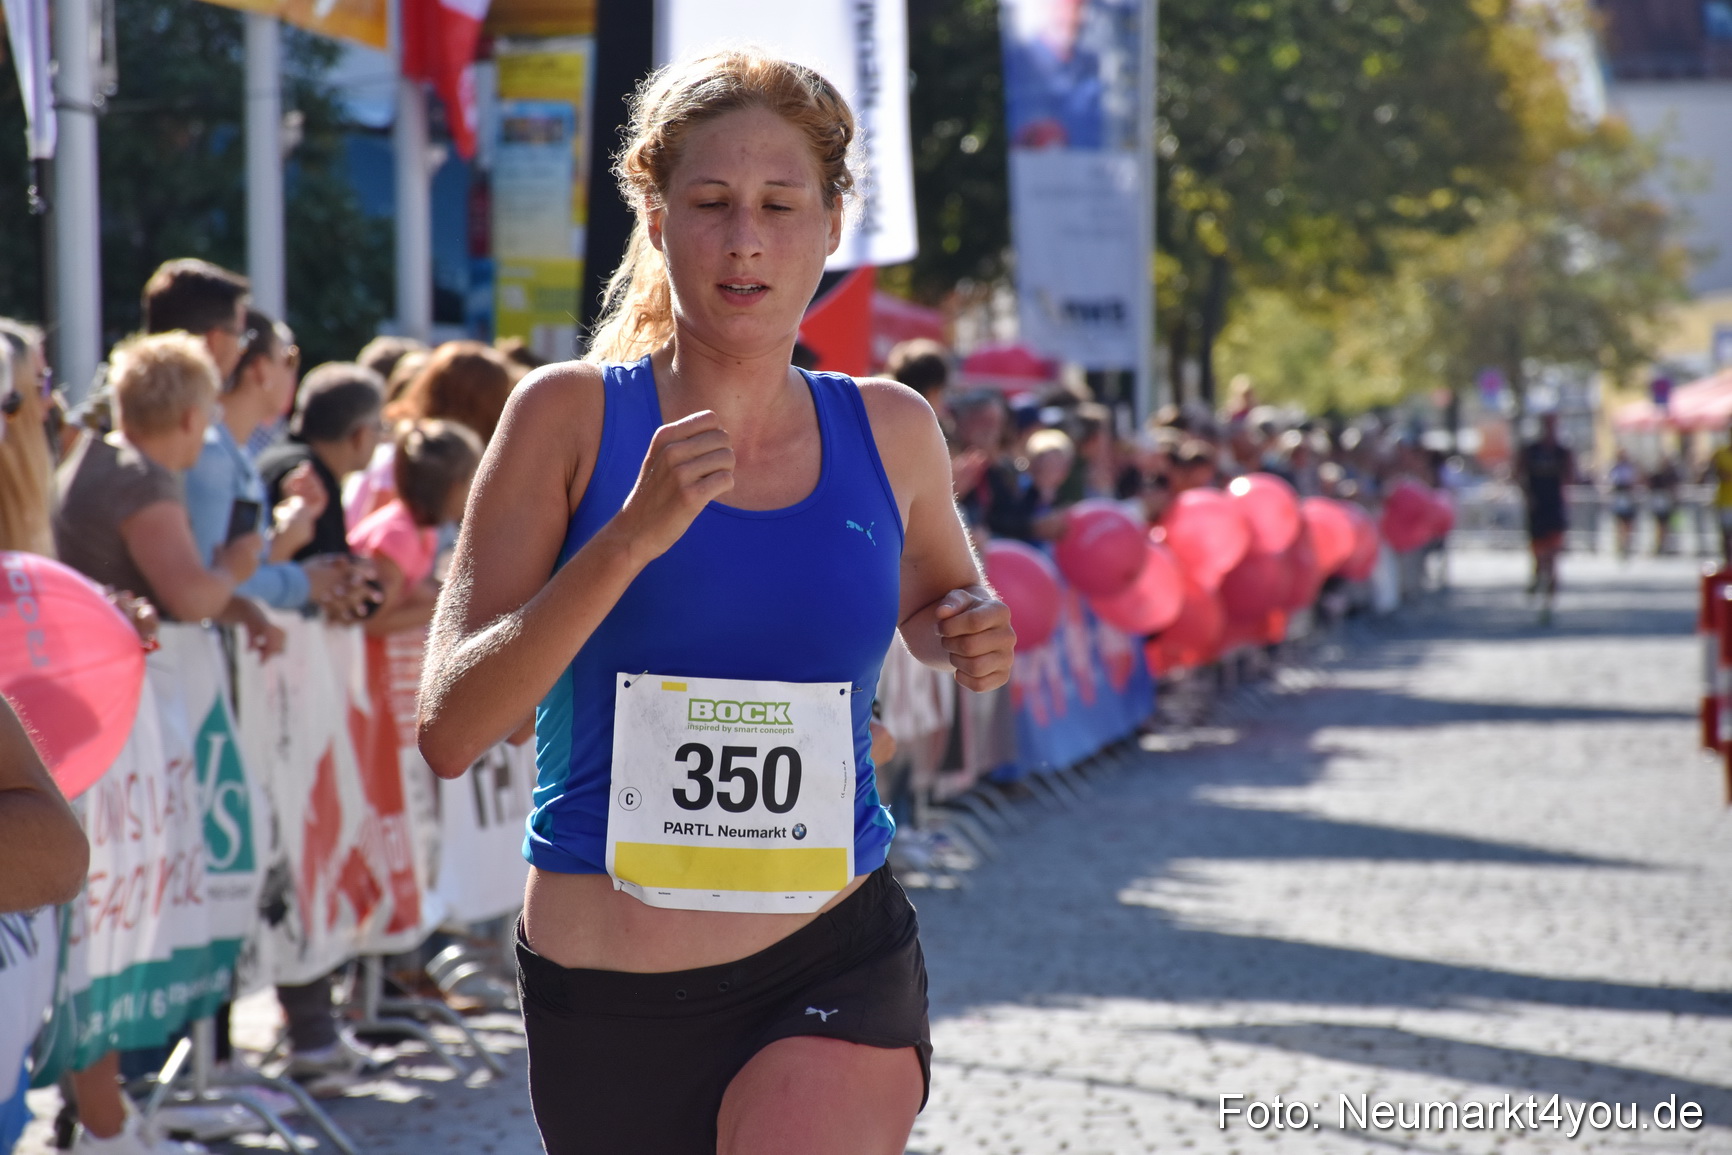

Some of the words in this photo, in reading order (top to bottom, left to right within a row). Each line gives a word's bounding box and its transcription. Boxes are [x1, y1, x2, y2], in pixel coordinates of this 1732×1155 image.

[688, 698, 793, 725] BOCK
[687, 722, 720, 732] inspired
[721, 724, 732, 734] by
[734, 726, 758, 734] smart
[759, 726, 795, 735] concepts
[672, 742, 803, 814] 350
[663, 821, 714, 837] PARTL
[717, 824, 787, 839] Neumarkt
